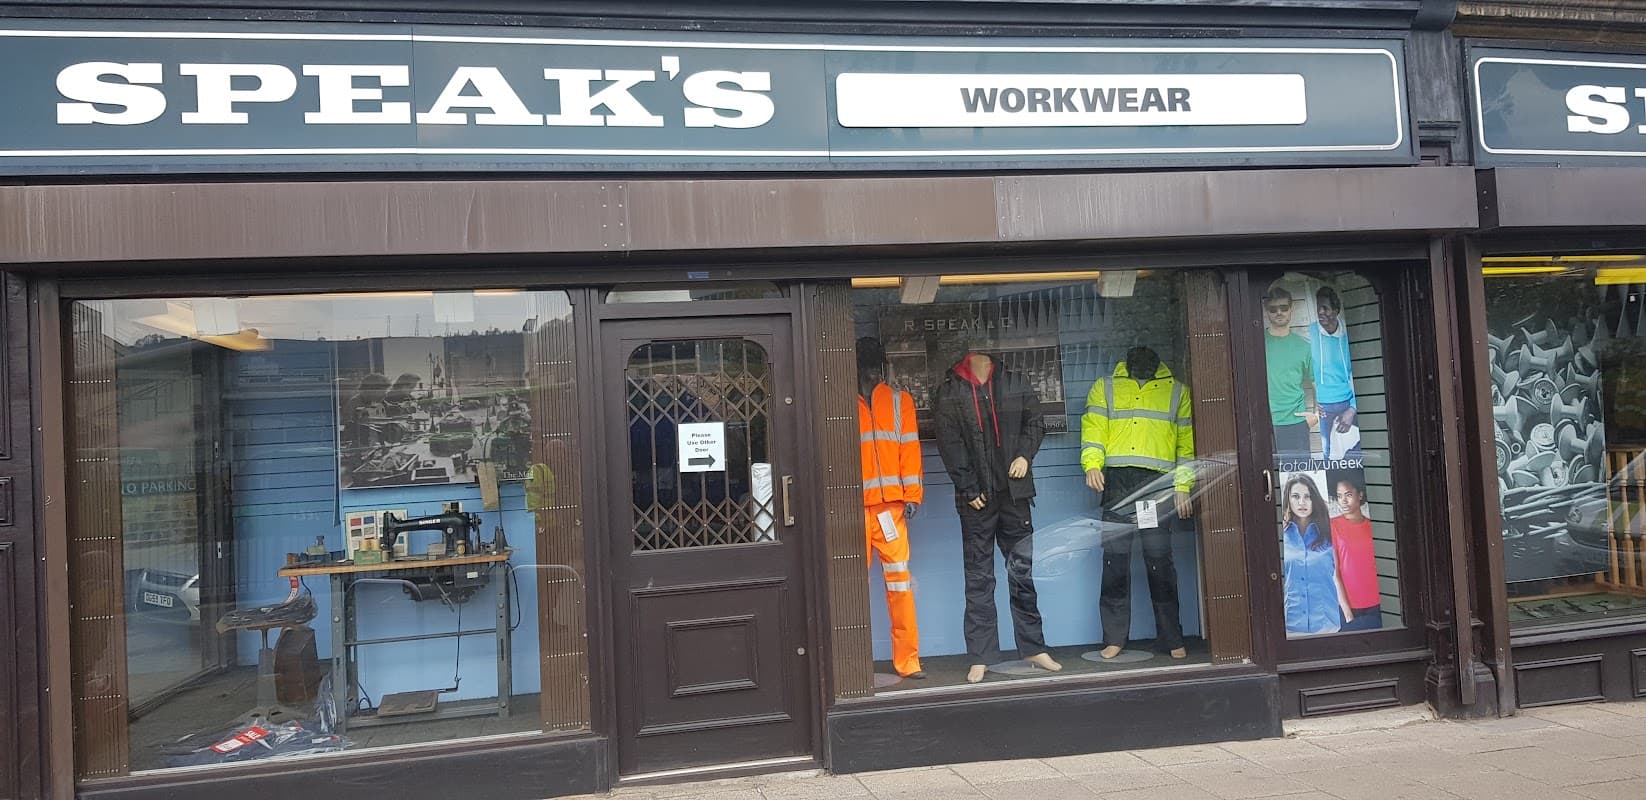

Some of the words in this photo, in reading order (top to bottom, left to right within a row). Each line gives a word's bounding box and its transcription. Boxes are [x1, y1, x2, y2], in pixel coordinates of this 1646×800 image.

[56, 56, 776, 129] SPEAK'S
[959, 87, 1193, 113] WORKWEAR
[904, 320, 914, 331] R
[924, 319, 982, 331] SPEAK
